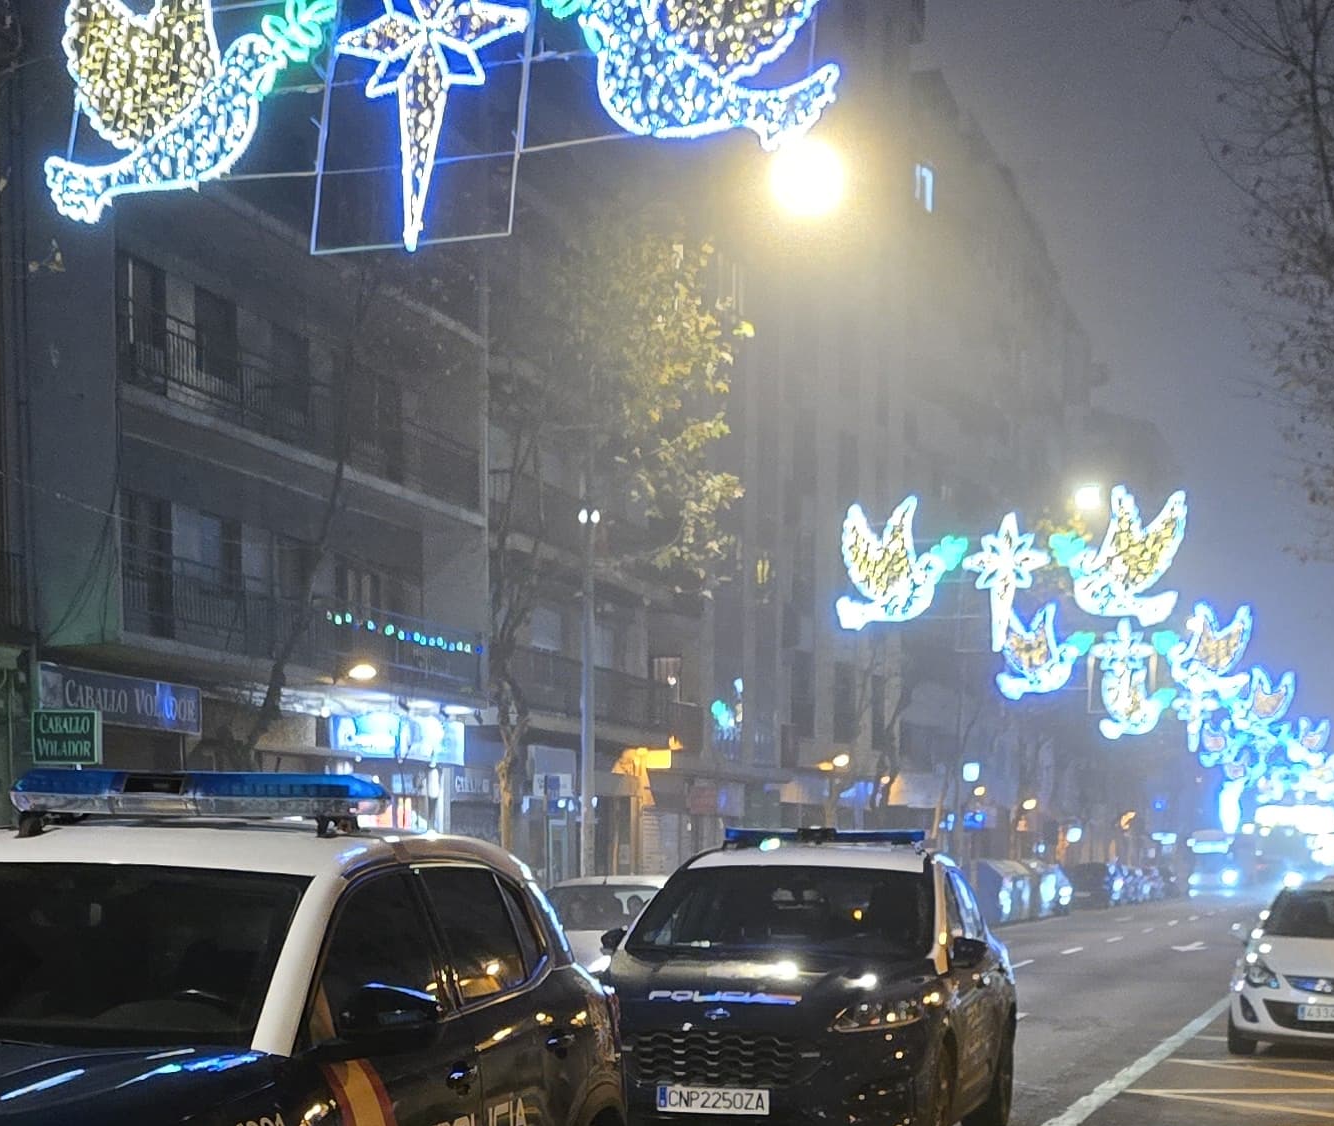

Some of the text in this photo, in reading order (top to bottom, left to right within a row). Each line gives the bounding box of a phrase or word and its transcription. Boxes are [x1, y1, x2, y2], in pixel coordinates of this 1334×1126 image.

[65, 679, 128, 714] CABALLO
[38, 713, 91, 734] CABALLO
[36, 738, 92, 757] VOLADOR
